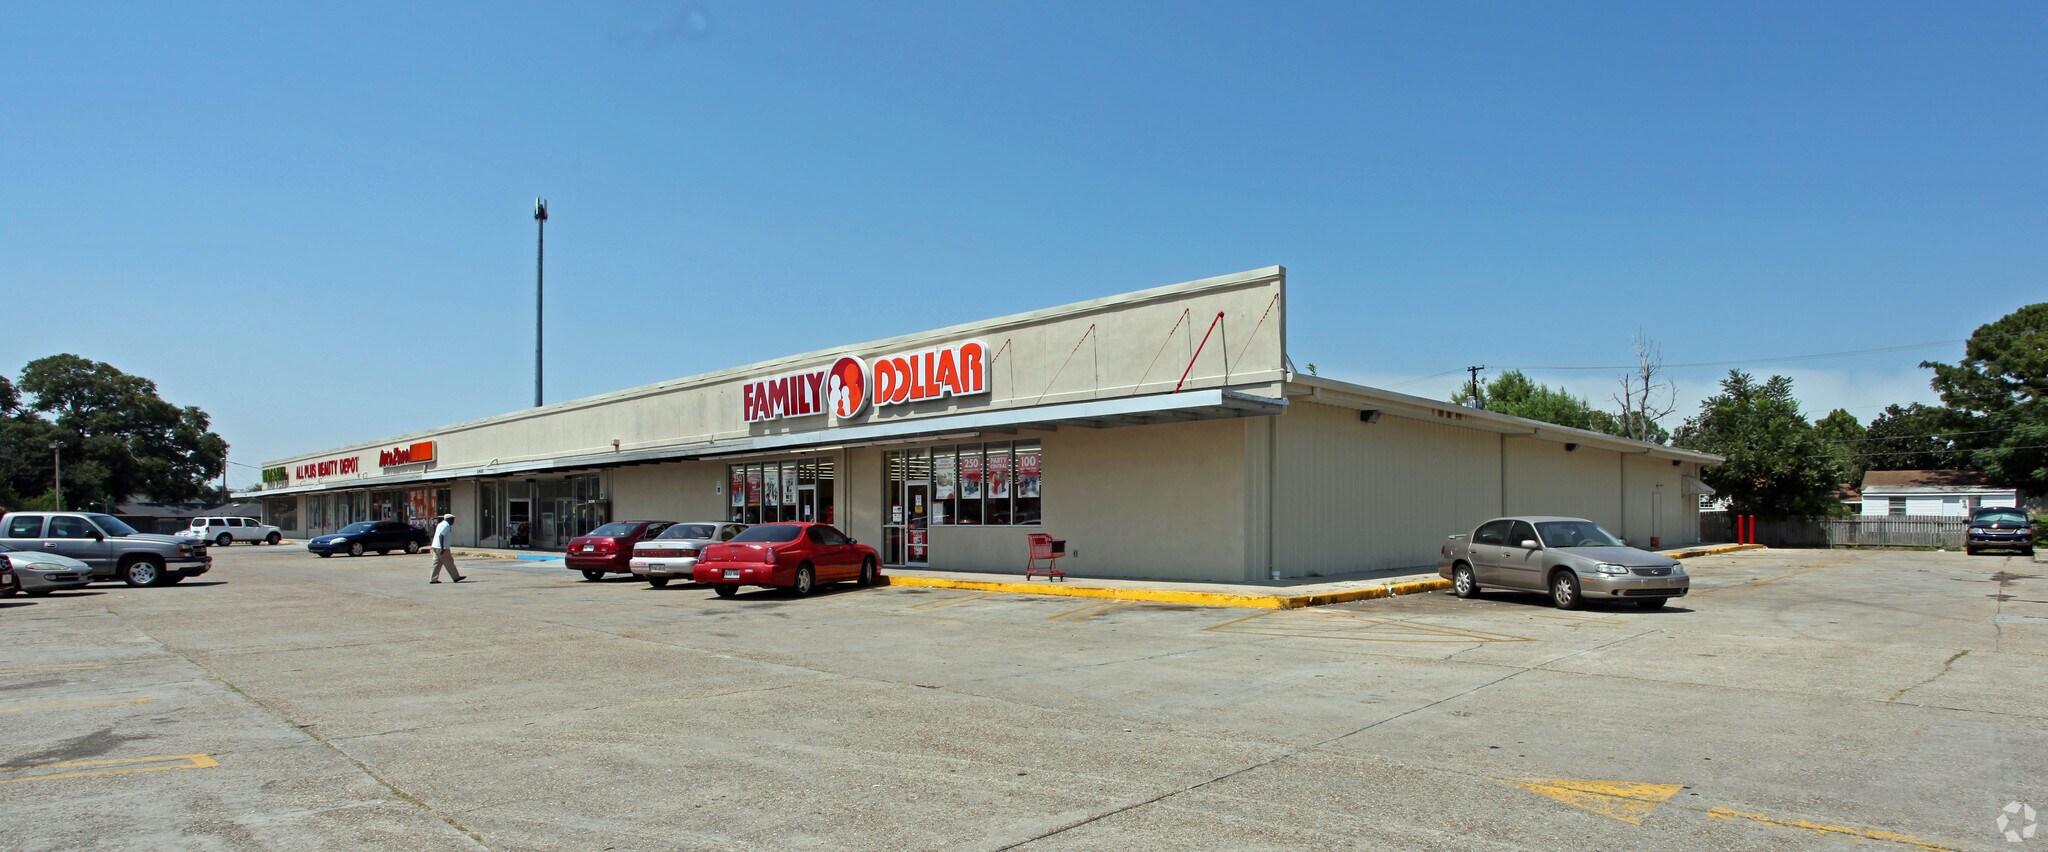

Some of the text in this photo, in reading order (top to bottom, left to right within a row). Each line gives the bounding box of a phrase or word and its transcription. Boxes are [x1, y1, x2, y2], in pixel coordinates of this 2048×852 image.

[743, 342, 983, 422] FAMILY DOLLAR
[964, 458, 979, 468] 250
[1021, 456, 1036, 467] 100
[296, 466, 304, 479] ALL
[305, 463, 317, 478] PLUS
[317, 459, 338, 477] BEAUTY
[339, 456, 359, 475] DEPOT
[733, 474, 743, 483] 250
